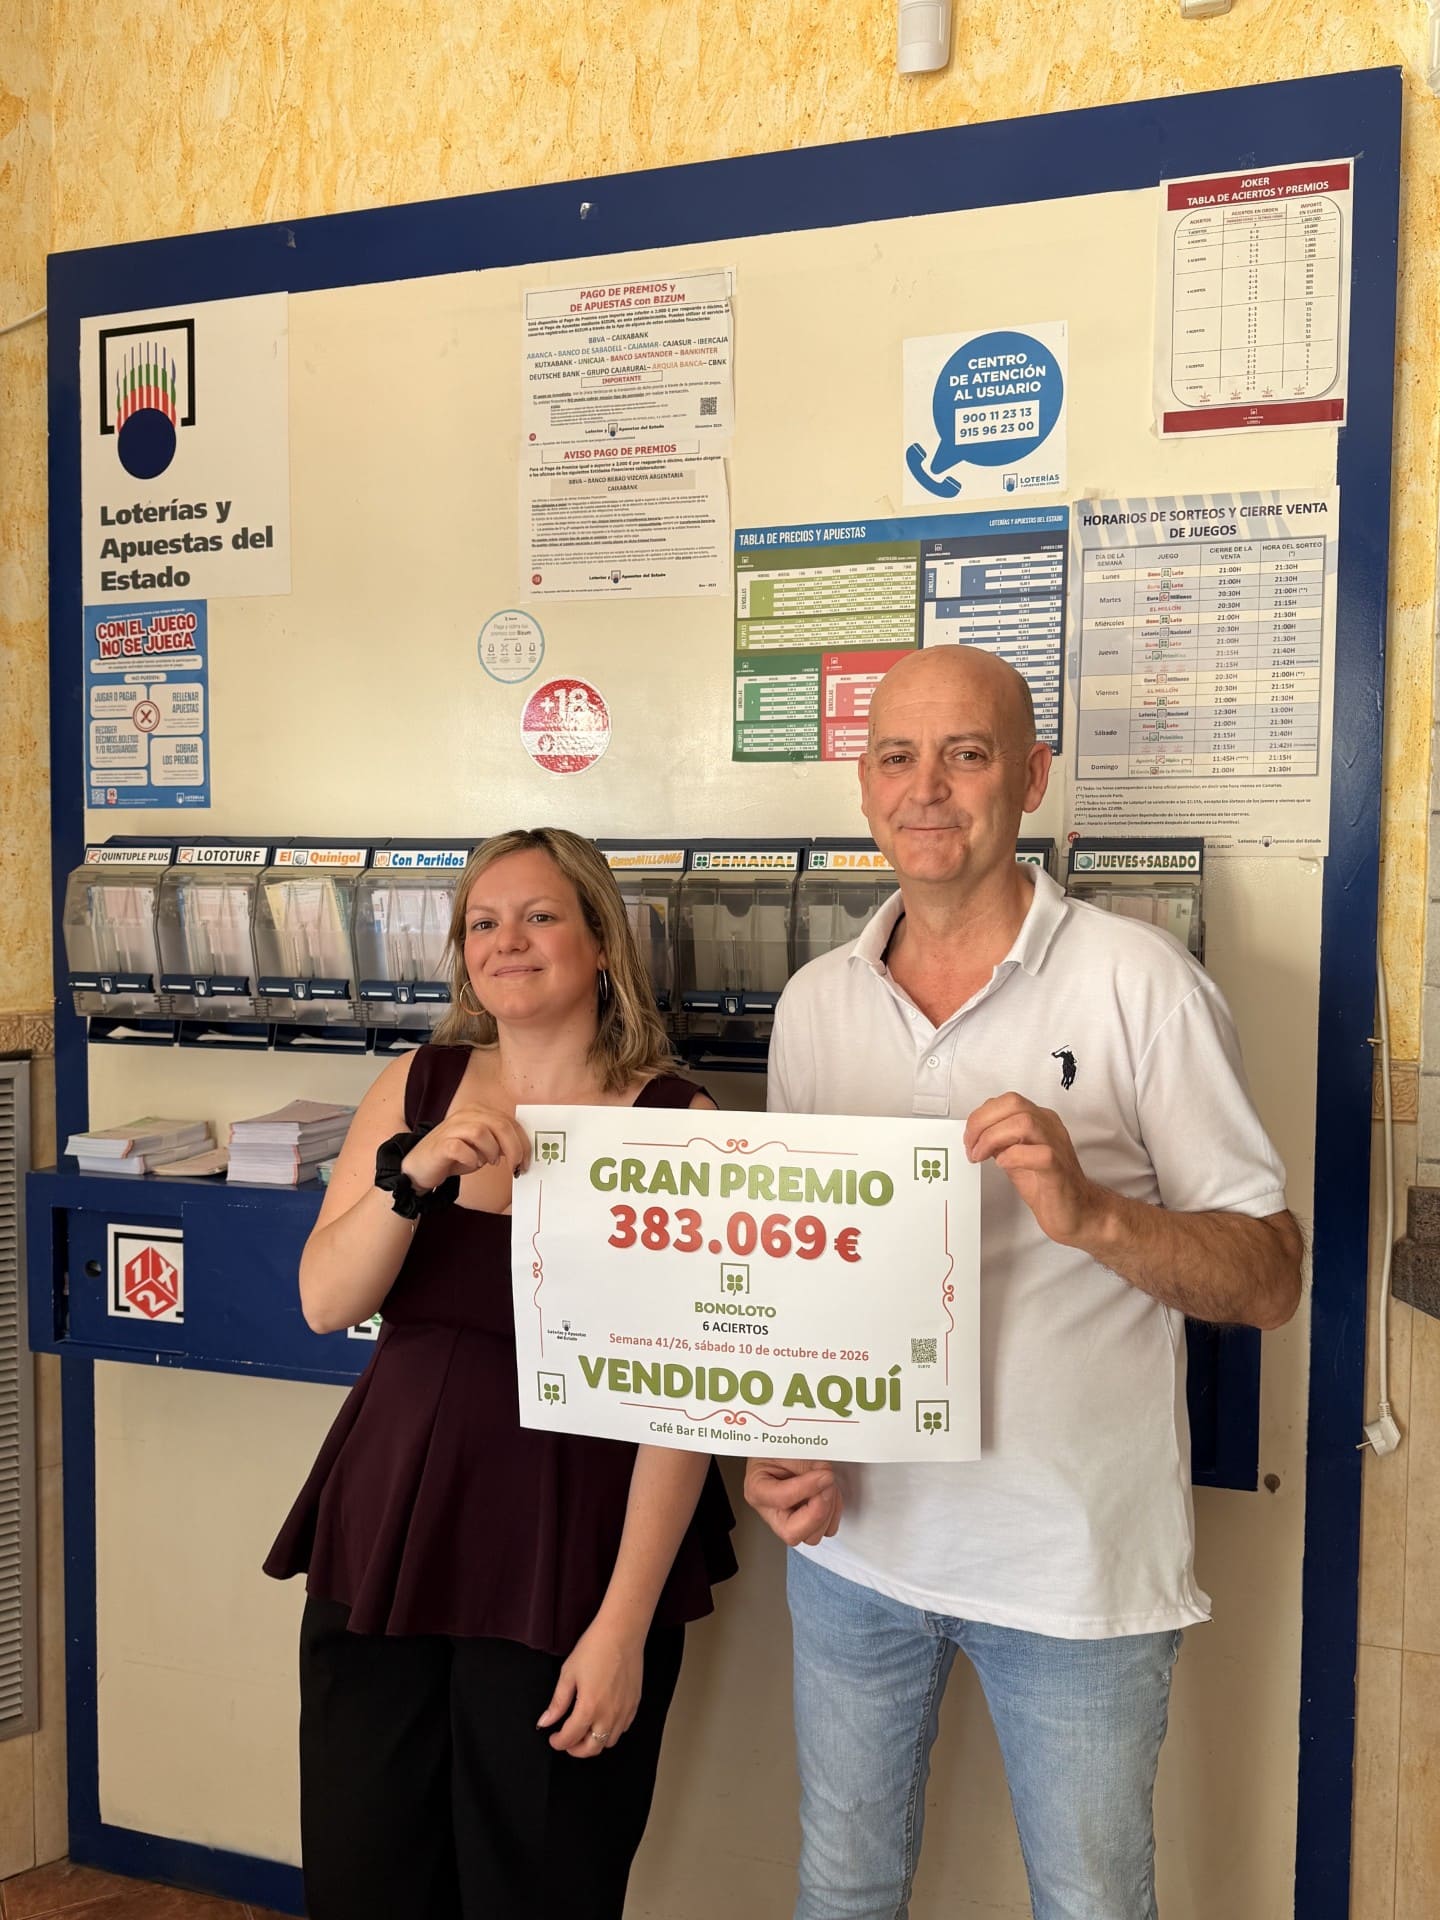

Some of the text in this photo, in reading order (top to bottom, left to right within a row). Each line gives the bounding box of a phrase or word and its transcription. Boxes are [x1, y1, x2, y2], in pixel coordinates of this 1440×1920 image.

[1240, 177, 1270, 188] JOKER
[1187, 181, 1329, 206] TABLA DE ACIERTOS Y PREMIOS
[580, 284, 676, 299] PAGO DE PREMIOS y
[570, 304, 582, 312] DE
[585, 298, 632, 311] APUESTAS
[654, 294, 686, 304] BIZUM
[592, 345, 622, 354] SABADELL
[663, 339, 692, 348] CAJASUR
[697, 336, 728, 346] IBERCAJA
[612, 333, 649, 342] CAIXABANK
[535, 348, 718, 368] KUTXABANK UNICAJA BANCO SANTANDER BANKINTER
[968, 353, 1027, 370] CENTRO
[530, 373, 561, 381] DEUTSCHE
[587, 368, 609, 376] GRUPO
[602, 375, 641, 384] IMPORTANTE
[950, 365, 1046, 387] DE ATENCIÓN
[954, 381, 1041, 401] AL USUARIO
[963, 408, 1032, 423] 900 11 23 13
[960, 421, 1034, 438] 915 96 23 00
[564, 444, 677, 459] AVISO PAGO DE PREMIOS
[1020, 473, 1060, 484] LOTERÍAS
[100, 498, 232, 526] Loterías y
[1083, 502, 1328, 526] HORARIOS DE SORTEOS Y CIERRE VENTA
[739, 526, 866, 546] TABLA DE PRECIOS Y APUESTAS
[1170, 525, 1236, 538] DE JUEGOS
[100, 526, 274, 562] Apuestas del
[100, 566, 190, 592] Estado
[98, 614, 196, 639] CON EL JUEGO
[101, 632, 194, 656] NO SE JUEGA
[95, 691, 137, 702] JUGAR O PAGAR
[172, 692, 199, 702] RELLENAR
[172, 704, 199, 713] APUESTAS
[176, 744, 198, 754] COBRAR
[163, 755, 199, 765] LOS PREMIOS
[101, 852, 168, 861] QUINTUPLE PLUS
[197, 850, 261, 862] LOTOTURF
[279, 851, 360, 865] El Quinigol
[392, 853, 464, 866] Con Partidos
[711, 855, 795, 867] SEMANAL
[832, 855, 890, 867] DIAR
[1096, 855, 1197, 868] JUEVES+SABADO
[590, 1157, 895, 1207] GRAN PREMIO
[607, 1204, 862, 1263] 383.069 €
[131, 1258, 175, 1312] 1 X 2
[694, 1302, 777, 1318] BONOLOTO
[702, 1320, 769, 1336] 6 ACIERTOS
[609, 1332, 869, 1362] Semana 41/26, sábado 10 de octubre de 2026
[578, 1354, 903, 1418] VENDIDO AQUÍ
[650, 1421, 673, 1435] Café
[677, 1424, 695, 1438] Bar
[698, 1426, 707, 1438] El
[710, 1428, 751, 1443] Molino
[762, 1432, 828, 1446] Pozohondo
